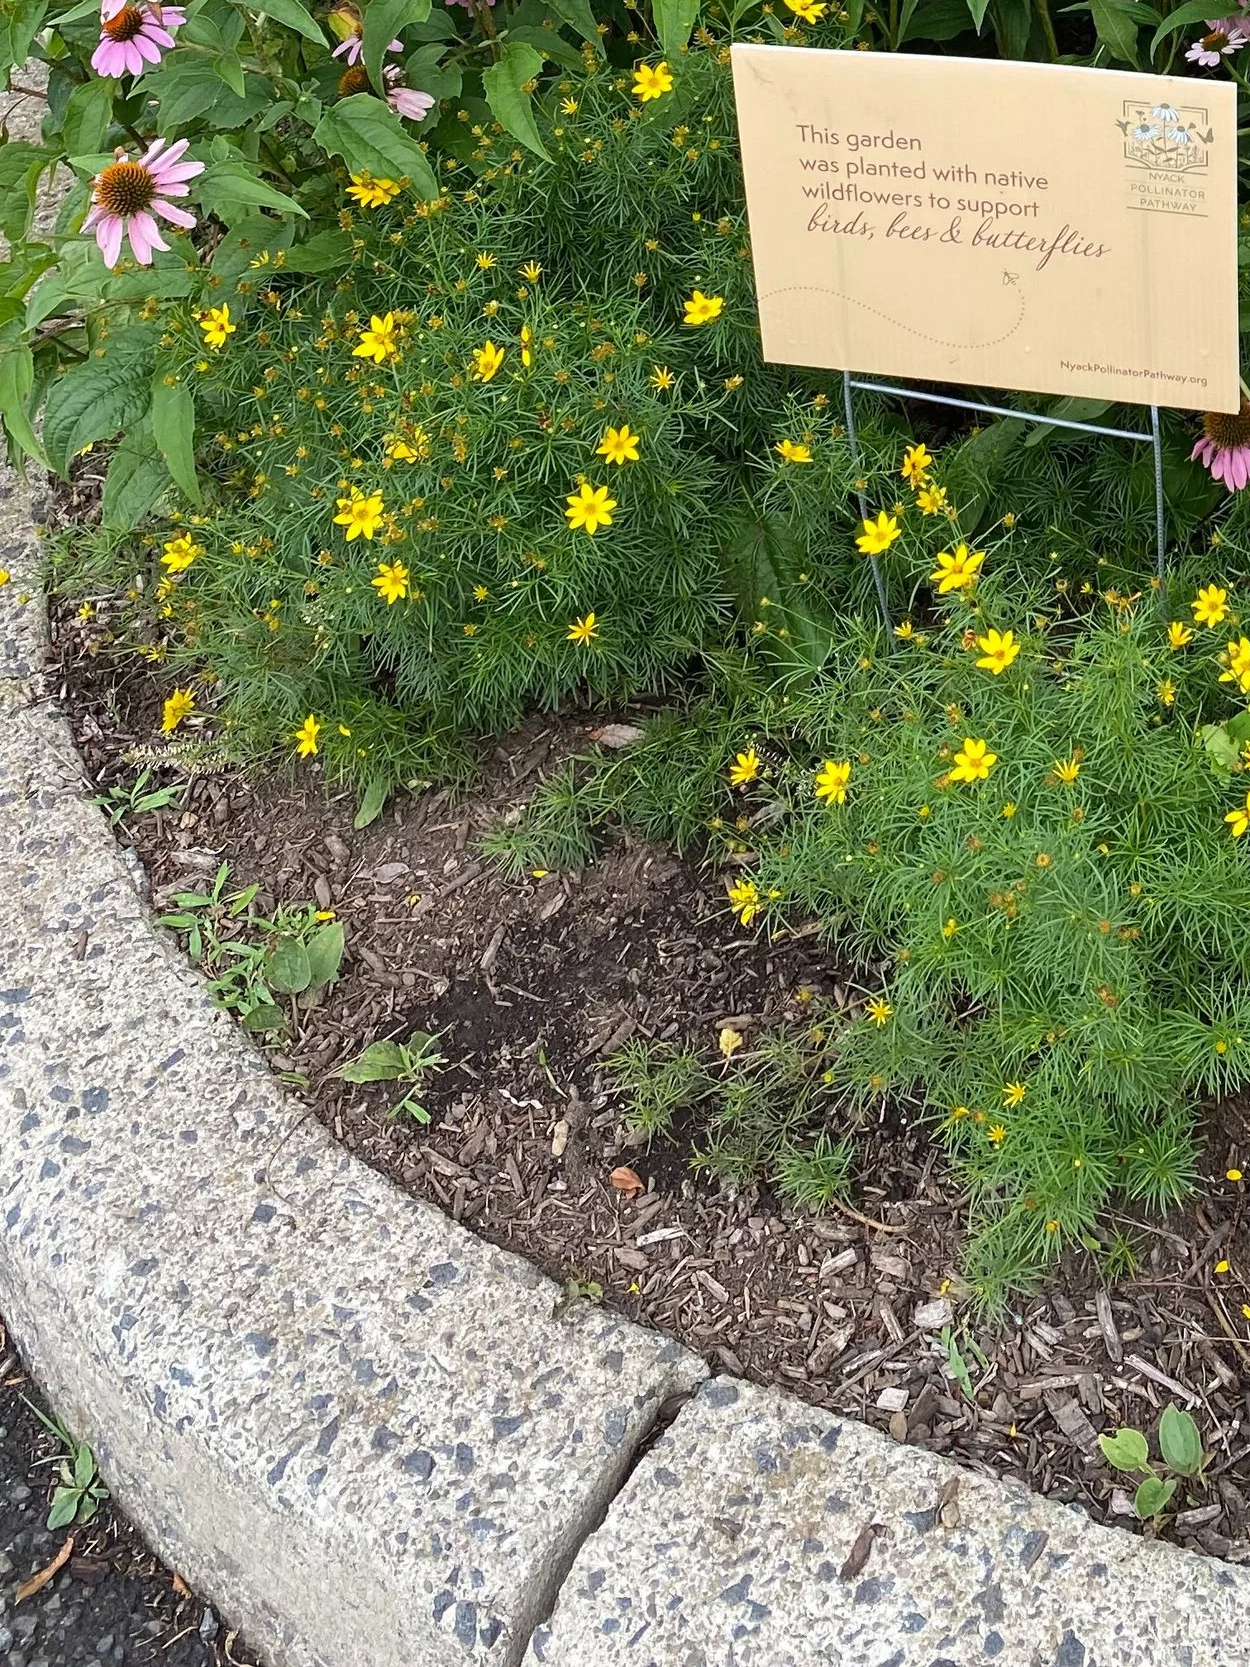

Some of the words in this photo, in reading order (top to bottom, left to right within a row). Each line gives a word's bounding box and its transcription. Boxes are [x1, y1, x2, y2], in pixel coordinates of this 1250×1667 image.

[796, 124, 840, 145] This
[846, 130, 922, 152] garden
[799, 157, 840, 173] was
[846, 156, 926, 179] planted
[933, 164, 977, 184] with
[984, 171, 1049, 190] native
[1148, 172, 1186, 184] NYACK
[802, 181, 923, 208] wildflowers
[928, 193, 951, 210] to
[957, 198, 1040, 219] support
[1130, 183, 1206, 200] POLLINATOR
[1140, 197, 1197, 212] PATHWAY
[807, 202, 876, 241] birds,
[886, 211, 939, 241] bees
[939, 216, 964, 244] &
[971, 215, 1112, 272] butterflies
[1060, 360, 1208, 388] NyackPollinatorPathway.org
